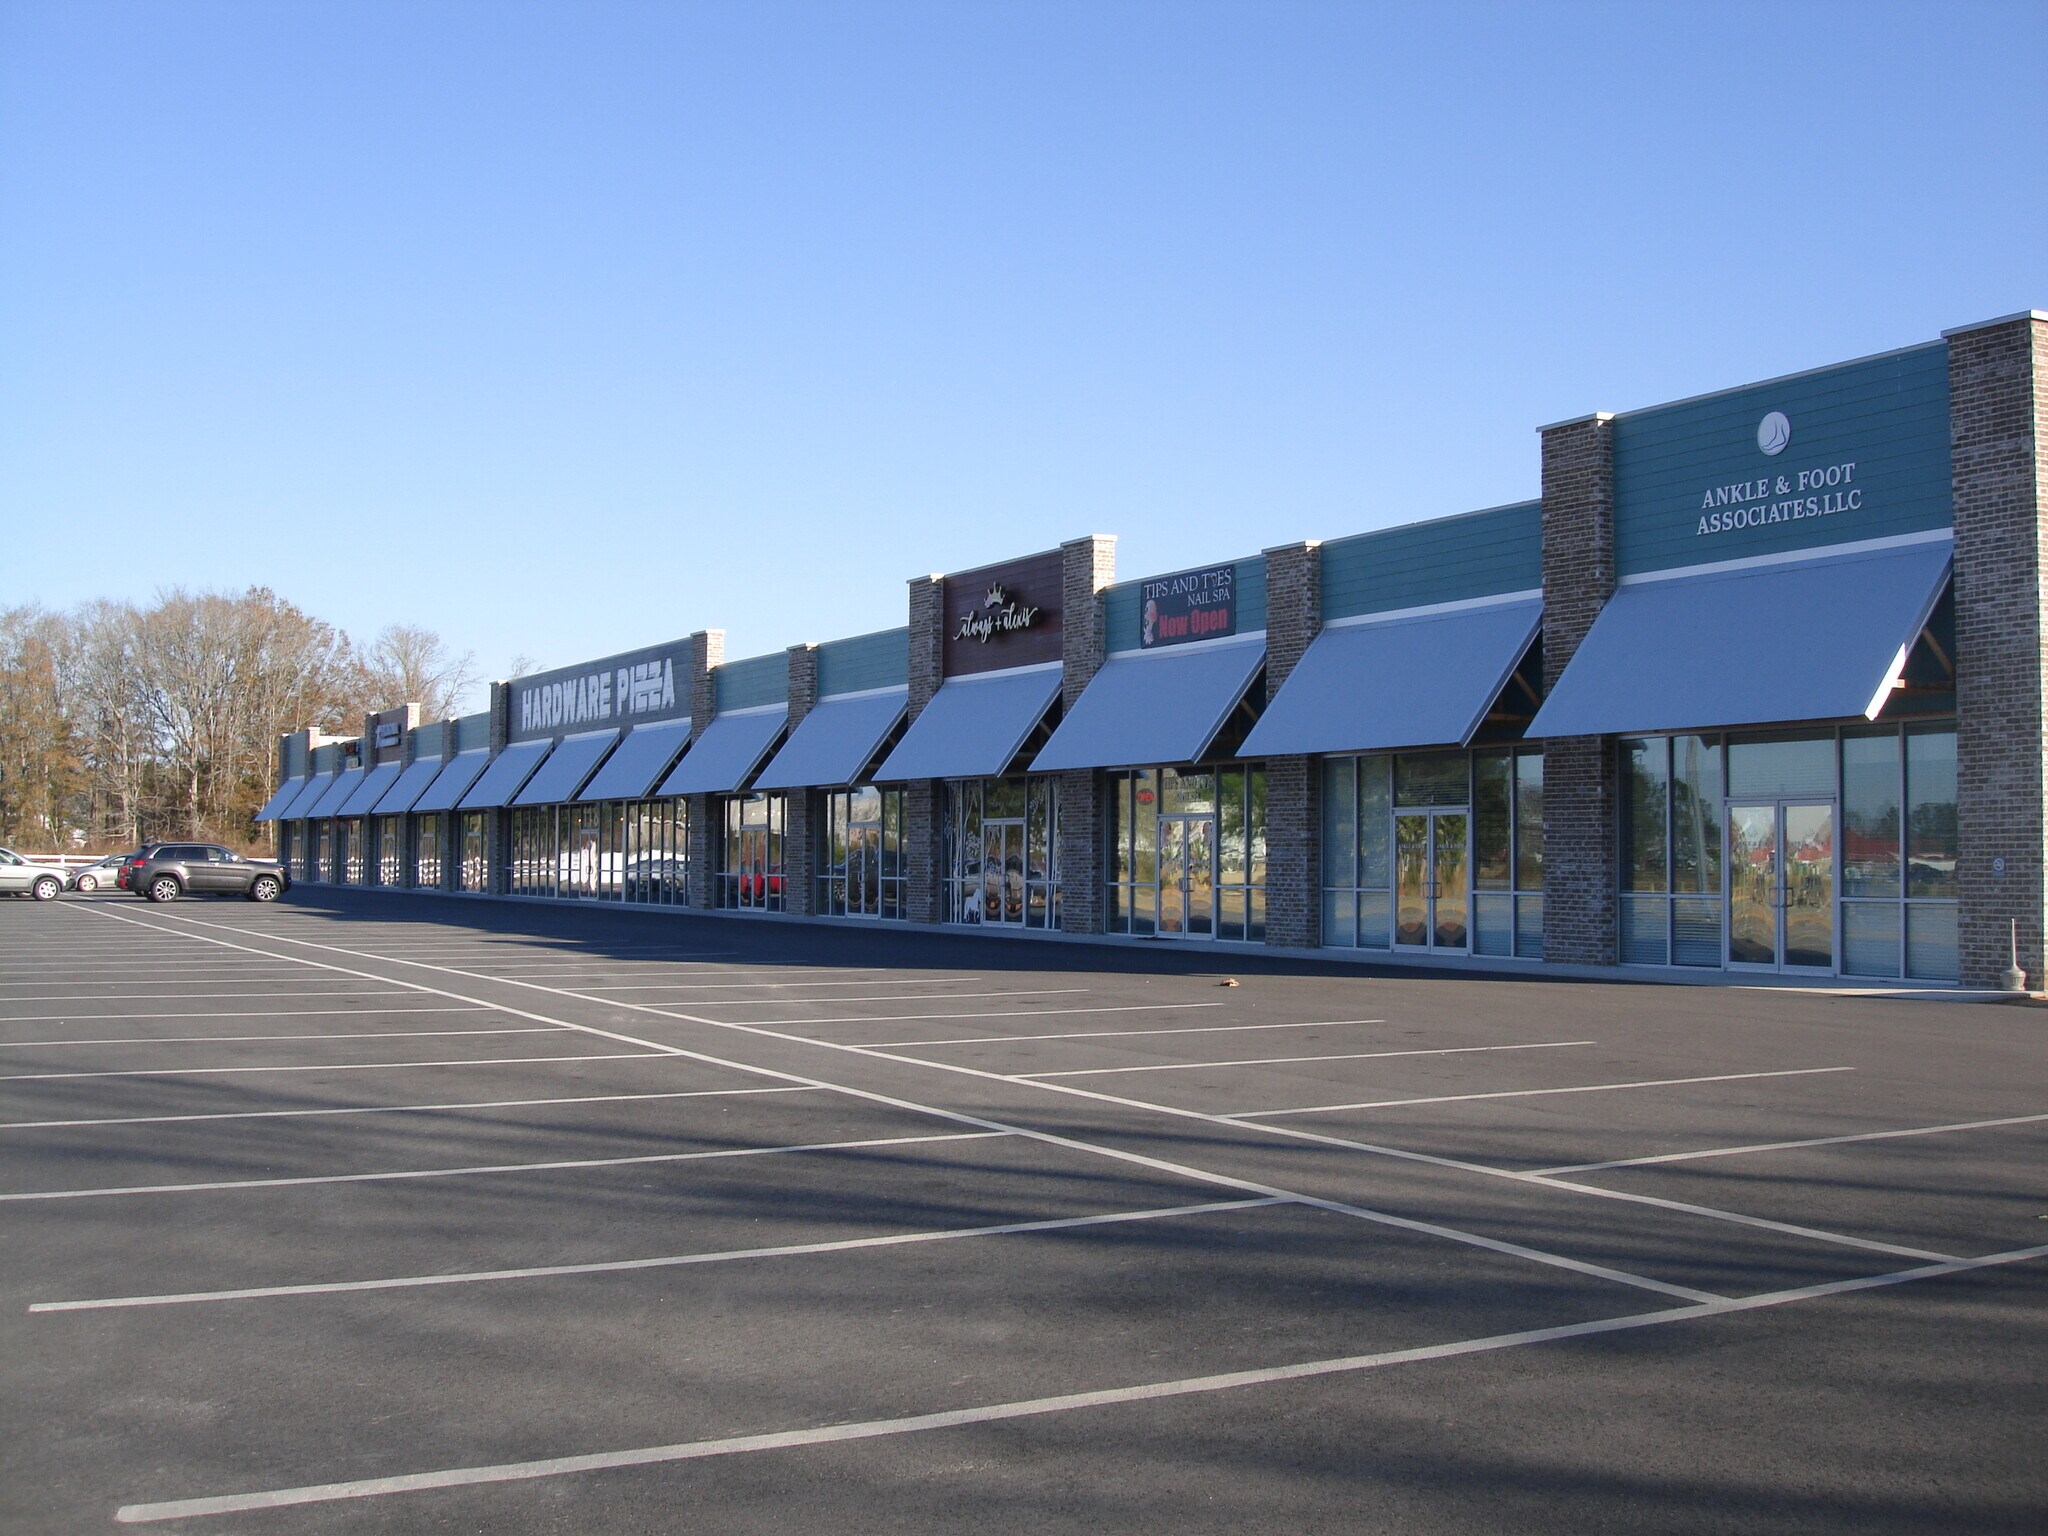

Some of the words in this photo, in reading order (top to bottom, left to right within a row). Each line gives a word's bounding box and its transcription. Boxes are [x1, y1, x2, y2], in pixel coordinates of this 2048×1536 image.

[1701, 478, 1770, 509] ANKLE
[1774, 475, 1791, 495] &
[1797, 462, 1856, 492] FOOT
[1143, 581, 1169, 600] TIPS
[1170, 575, 1199, 595] AND
[1187, 591, 1211, 607] NAIL
[1212, 587, 1231, 603] SPA
[1158, 614, 1188, 639] Now
[1190, 608, 1228, 635] Open
[521, 671, 611, 733] HARDWARE
[616, 657, 676, 717] PIZZA
